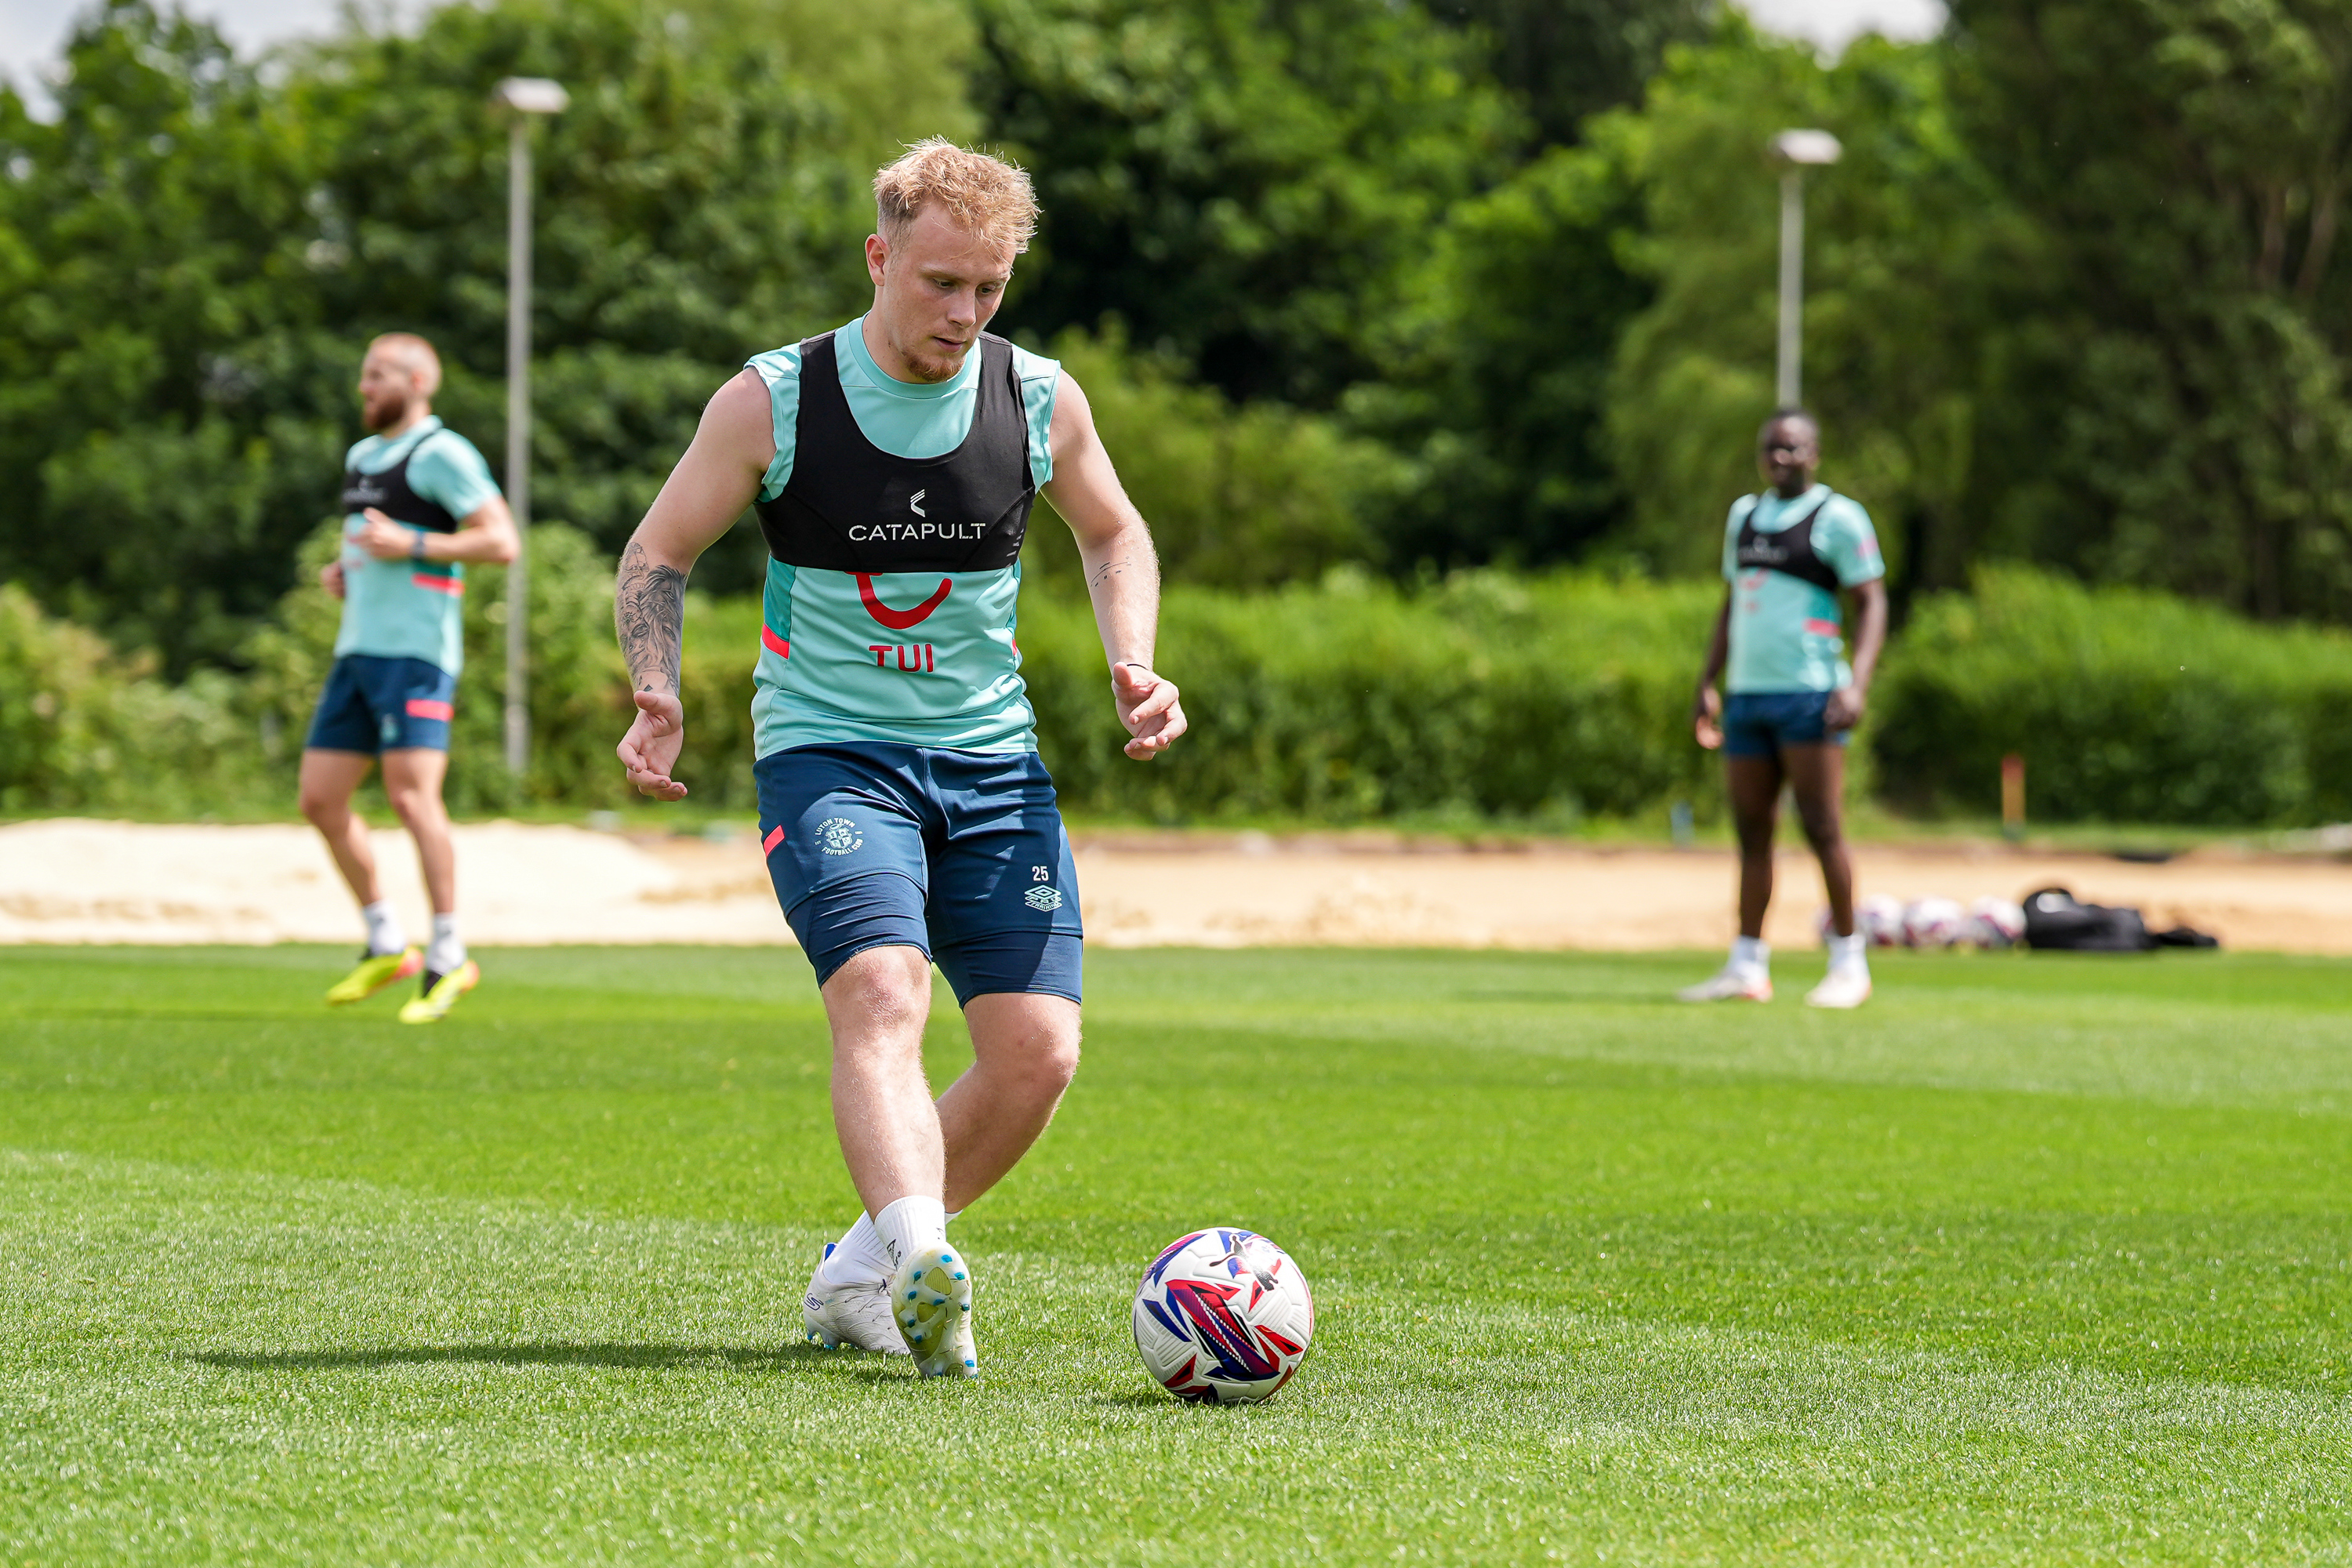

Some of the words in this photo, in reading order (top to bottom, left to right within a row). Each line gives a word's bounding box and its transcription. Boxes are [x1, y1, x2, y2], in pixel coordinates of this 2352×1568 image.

[848, 522, 986, 542] CATAPULT
[869, 643, 935, 673] TUI
[815, 818, 833, 836] LUTON
[833, 818, 855, 828] TOWN
[821, 846, 854, 856] FOOTBALL
[1032, 866, 1049, 881] 25
